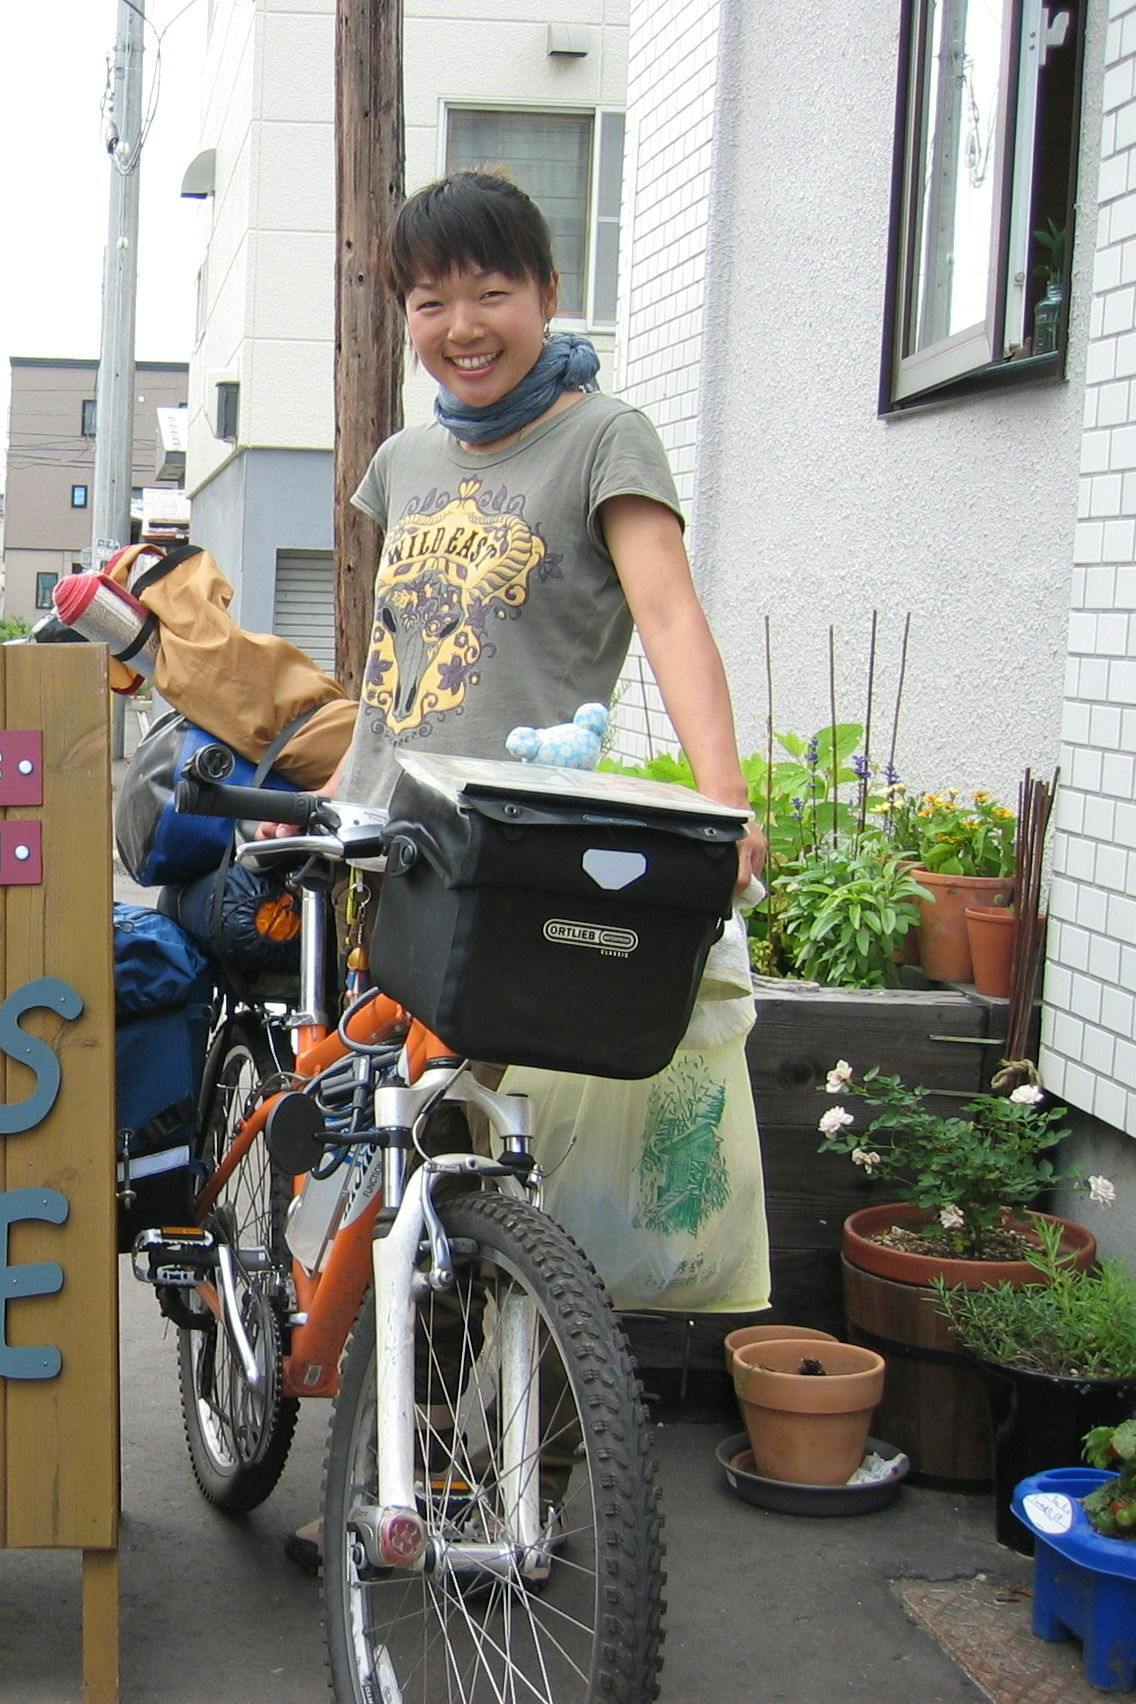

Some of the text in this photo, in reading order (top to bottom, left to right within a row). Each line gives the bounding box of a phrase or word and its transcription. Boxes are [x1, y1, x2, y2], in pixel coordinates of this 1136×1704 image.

[388, 526, 498, 568] WILD EAST
[550, 925, 595, 940] ORTLIEB
[363, 1161, 383, 1197] FUNCTION
